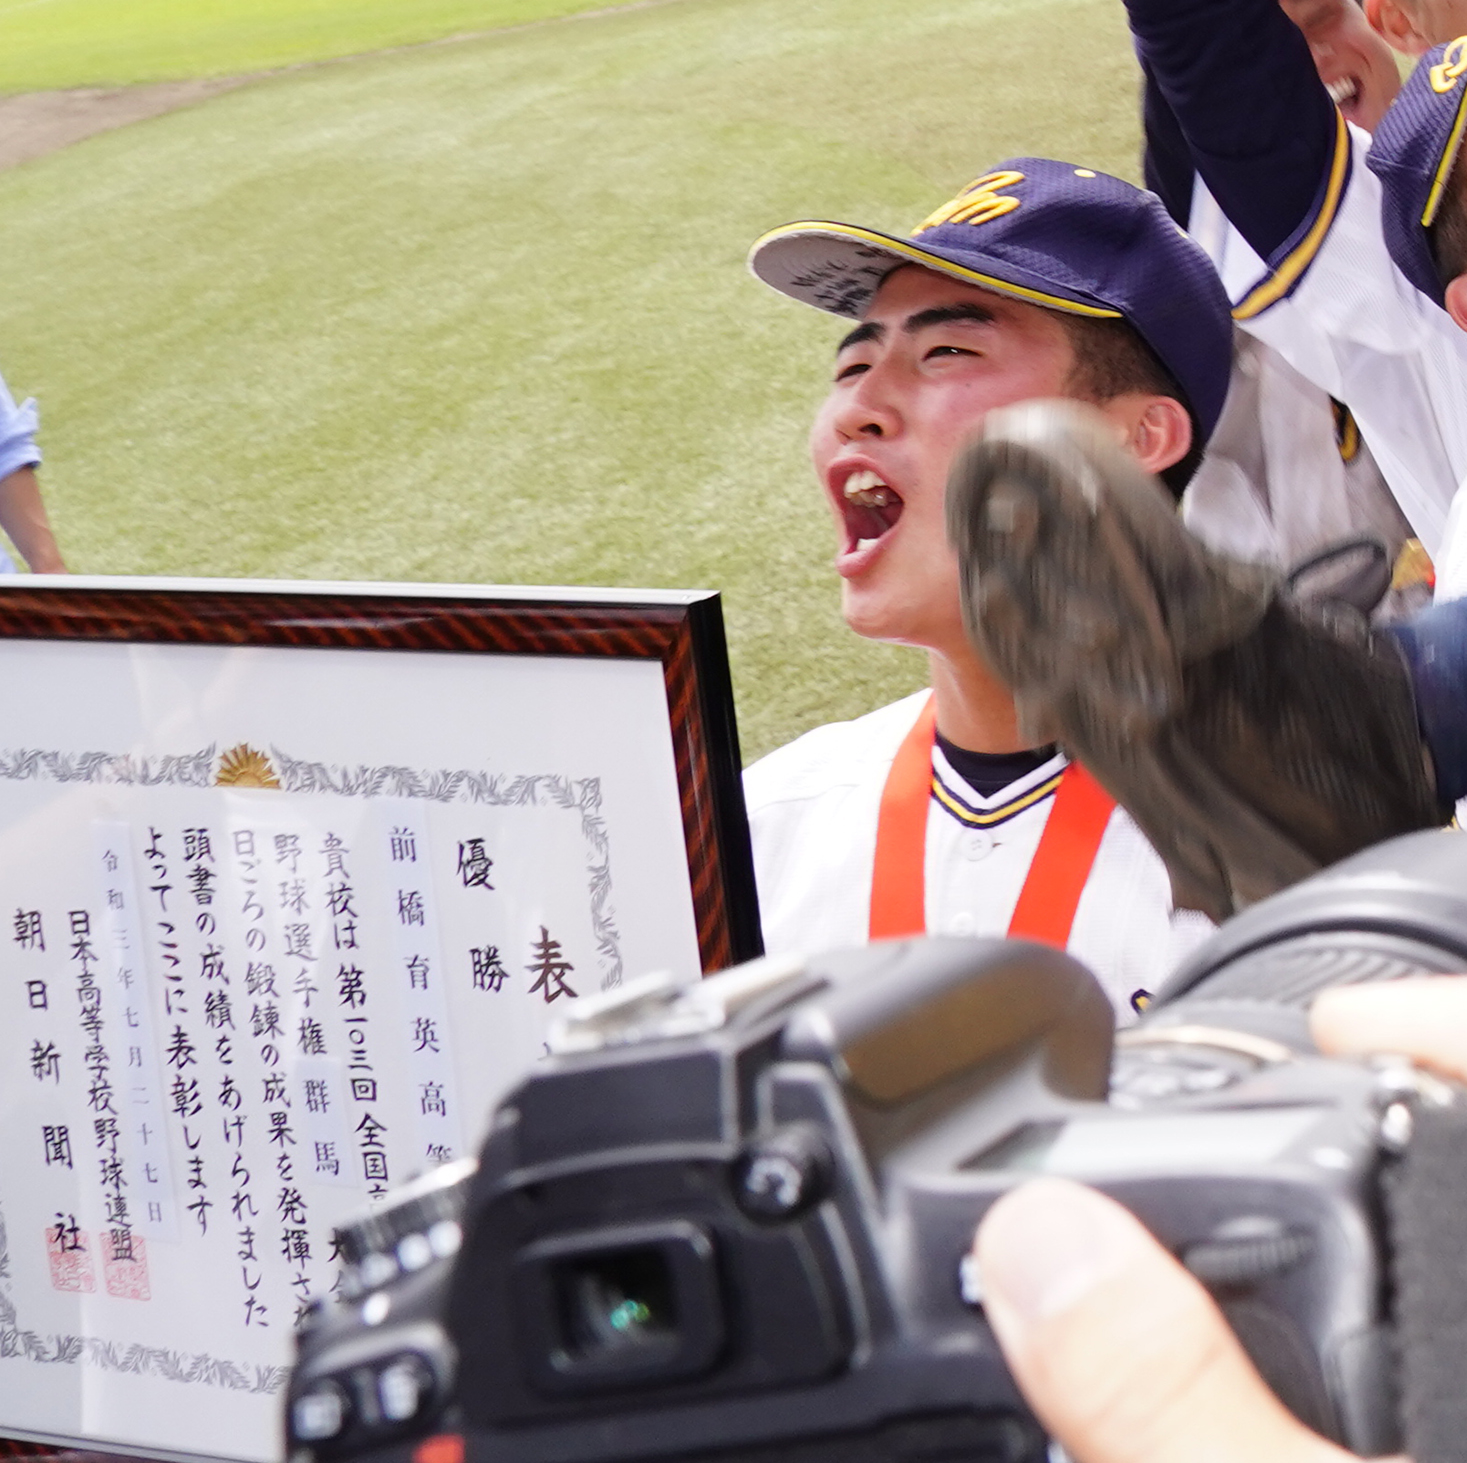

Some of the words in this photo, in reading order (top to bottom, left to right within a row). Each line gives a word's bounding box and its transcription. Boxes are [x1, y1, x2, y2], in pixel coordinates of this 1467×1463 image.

[13, 907, 87, 1253] 朝日新聞社
[68, 910, 137, 1263] 日本高等学校野球連盟
[143, 826, 213, 1237] よってここに表彰します
[455, 836, 511, 993] 優勝
